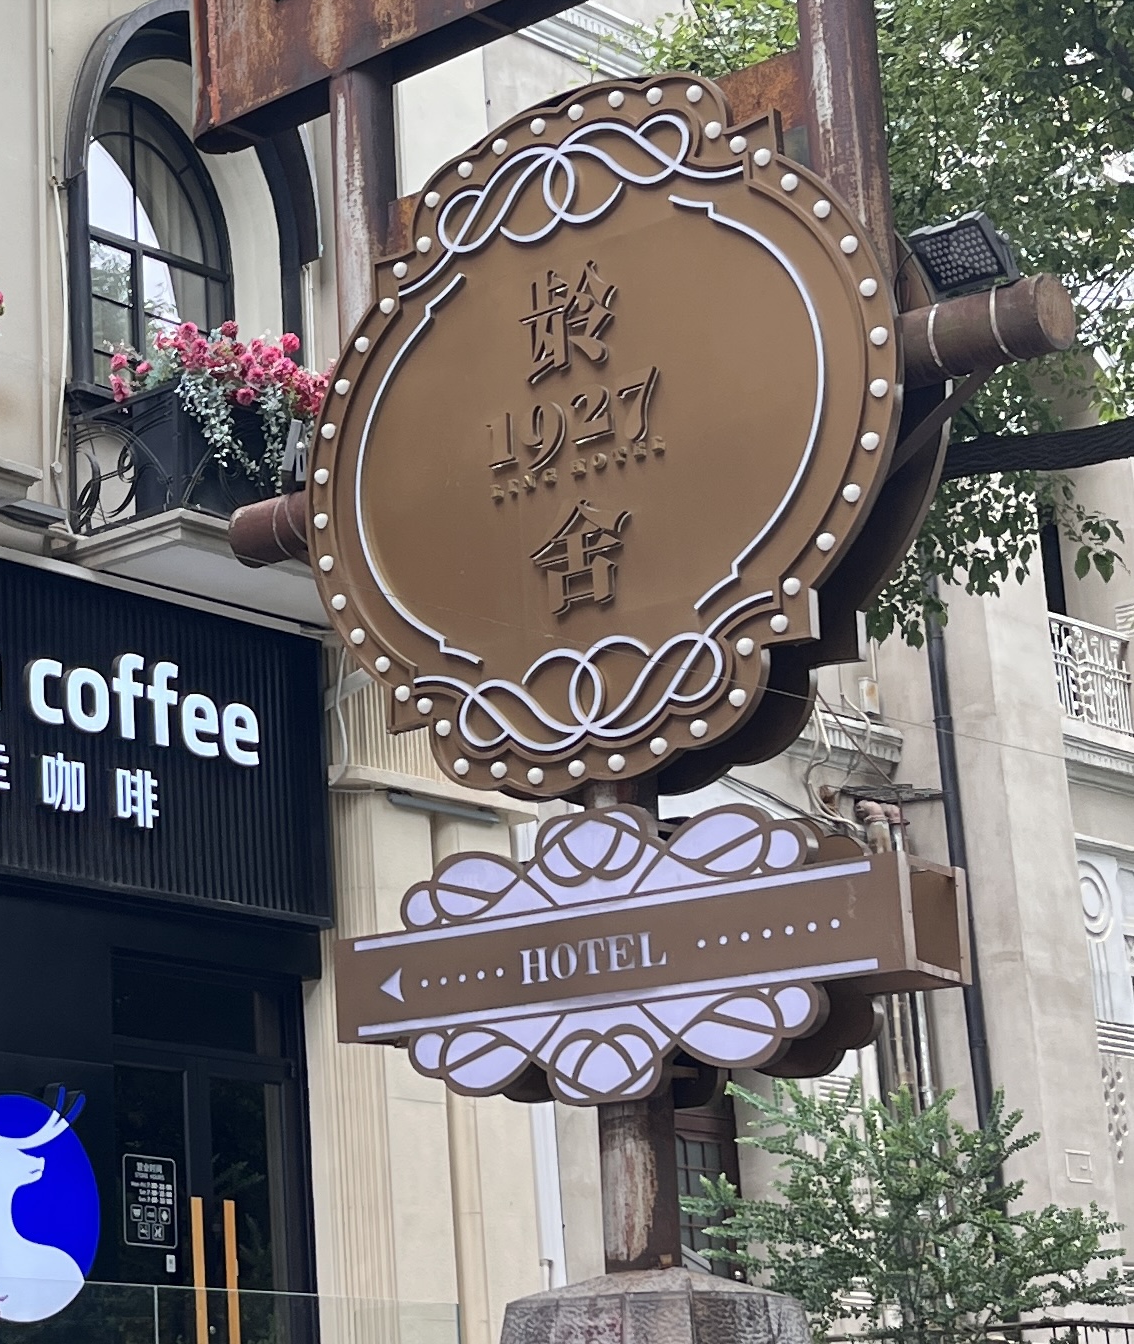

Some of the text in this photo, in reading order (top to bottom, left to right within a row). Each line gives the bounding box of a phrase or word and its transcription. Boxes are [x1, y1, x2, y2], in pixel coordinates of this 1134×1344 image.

[485, 365, 660, 471] 1927
[26, 652, 260, 767] coffee
[519, 931, 667, 985] HOTEL
